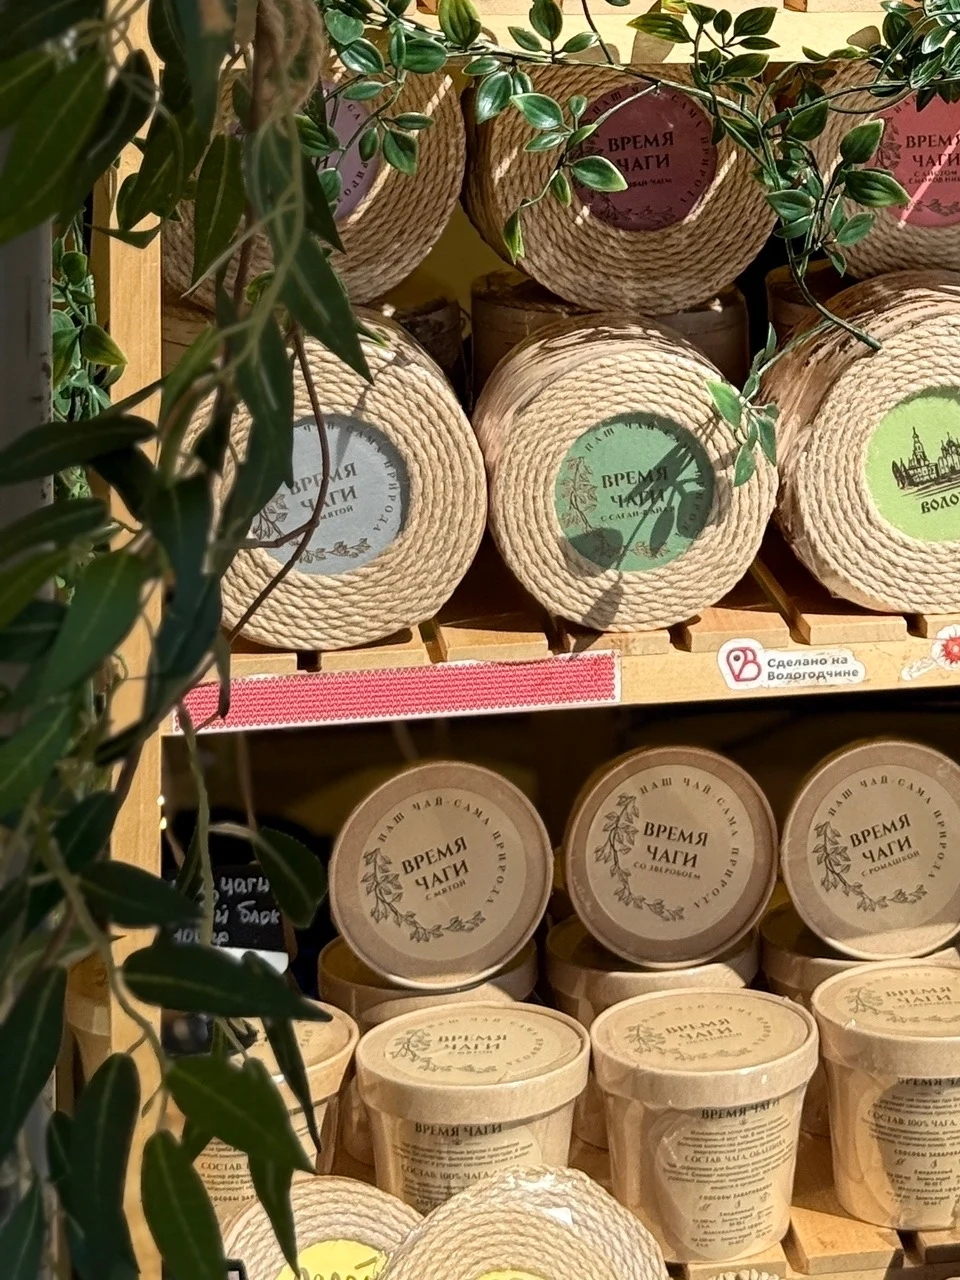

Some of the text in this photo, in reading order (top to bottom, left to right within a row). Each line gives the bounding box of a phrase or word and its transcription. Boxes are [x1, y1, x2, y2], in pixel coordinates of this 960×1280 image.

[608, 131, 674, 152] ВРЕМЯ
[616, 154, 670, 173] ЧАГИ
[913, 153, 960, 167] ЧАГИ
[290, 462, 358, 496] ВРЕМЯ
[601, 467, 668, 489] ВРЕМЯ
[300, 485, 358, 513] ЧАГИ
[610, 488, 665, 509] ЧАГИ
[767, 656, 849, 669] Сделано на
[767, 668, 859, 682] Вологодчине
[643, 821, 709, 848] ВРЕМЯ
[850, 813, 911, 848] ВРЕМЯ
[401, 836, 468, 874] ВРЕМЯ
[646, 844, 698, 868] ЧАГИ
[862, 835, 913, 863] ЧАГИ
[415, 859, 470, 891] ЧАГИ
[221, 877, 270, 896] чаги
[237, 900, 280, 925] блок
[885, 986, 952, 998] ВРЕМЯ
[896, 995, 951, 1004] ЧАГИ
[665, 1018, 730, 1035] ВРЕМЯ
[678, 1027, 734, 1040] ЧАГИ
[438, 1034, 507, 1043] ВРЕМЯ
[443, 1042, 500, 1050] ЧАГИ
[701, 1098, 780, 1120] ВРЕМЯ ЧАГИ
[415, 1122, 502, 1137] ВРЕМЯ ЧАГИ
